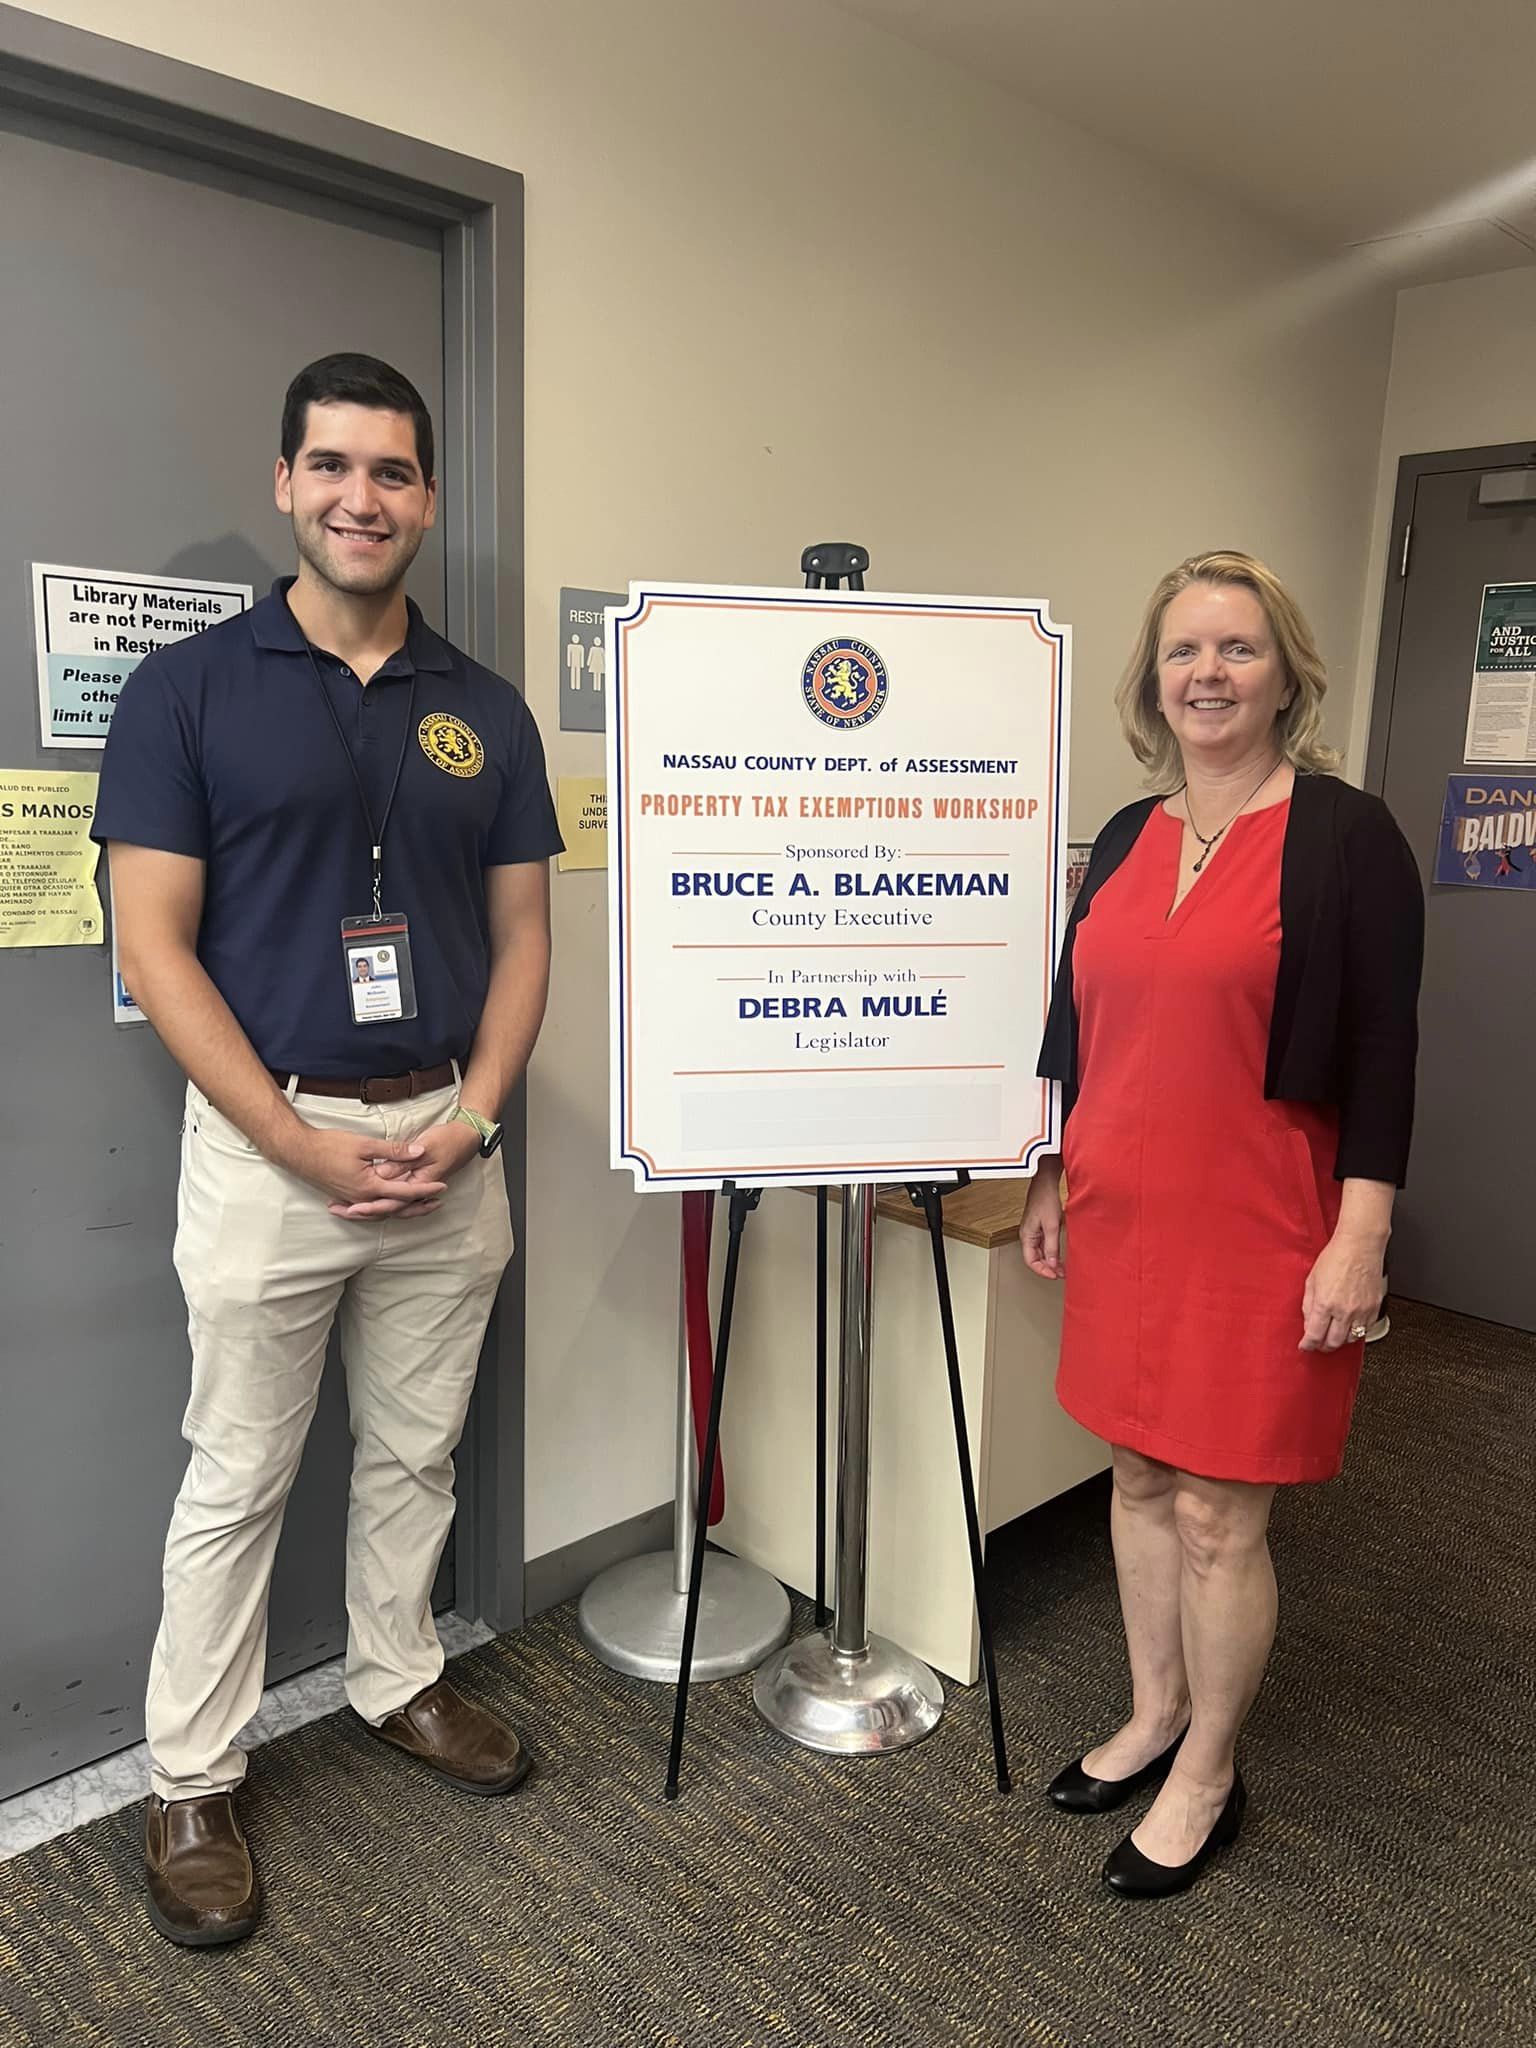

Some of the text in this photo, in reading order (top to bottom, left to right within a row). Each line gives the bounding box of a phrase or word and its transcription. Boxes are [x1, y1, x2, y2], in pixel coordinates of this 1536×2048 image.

[73, 584, 222, 614] Library Materials
[69, 611, 213, 632] are not Permitt
[1490, 635, 1536, 646] JUSTIC
[1491, 626, 1522, 637] AND
[94, 636, 169, 654] in Restr
[1505, 646, 1532, 657] ALL
[806, 641, 885, 677] NASSAU COUNTY
[63, 668, 122, 684] Please
[81, 690, 119, 703] othe
[53, 708, 113, 723] limit u
[805, 686, 886, 728] STATE OF NEW YORK
[663, 754, 1018, 774] NASSAU COUNTY DEPT. of ASSESSMENT
[590, 794, 608, 804] THI
[1465, 787, 1536, 807] DAN
[22, 803, 94, 819] MANOS
[641, 793, 1039, 820] PROPERTY TAX EXEMPTIONS WORKSHOP
[785, 844, 902, 862] Sponsored By:
[671, 872, 1009, 897] BRUCE A. BLAKEMAN
[2, 909, 36, 917] CONDADO
[752, 908, 933, 930] County Executive
[768, 969, 917, 986] In Partnership with
[739, 988, 947, 1019] DEBRA MULÉ
[795, 1031, 890, 1053] Legislator
